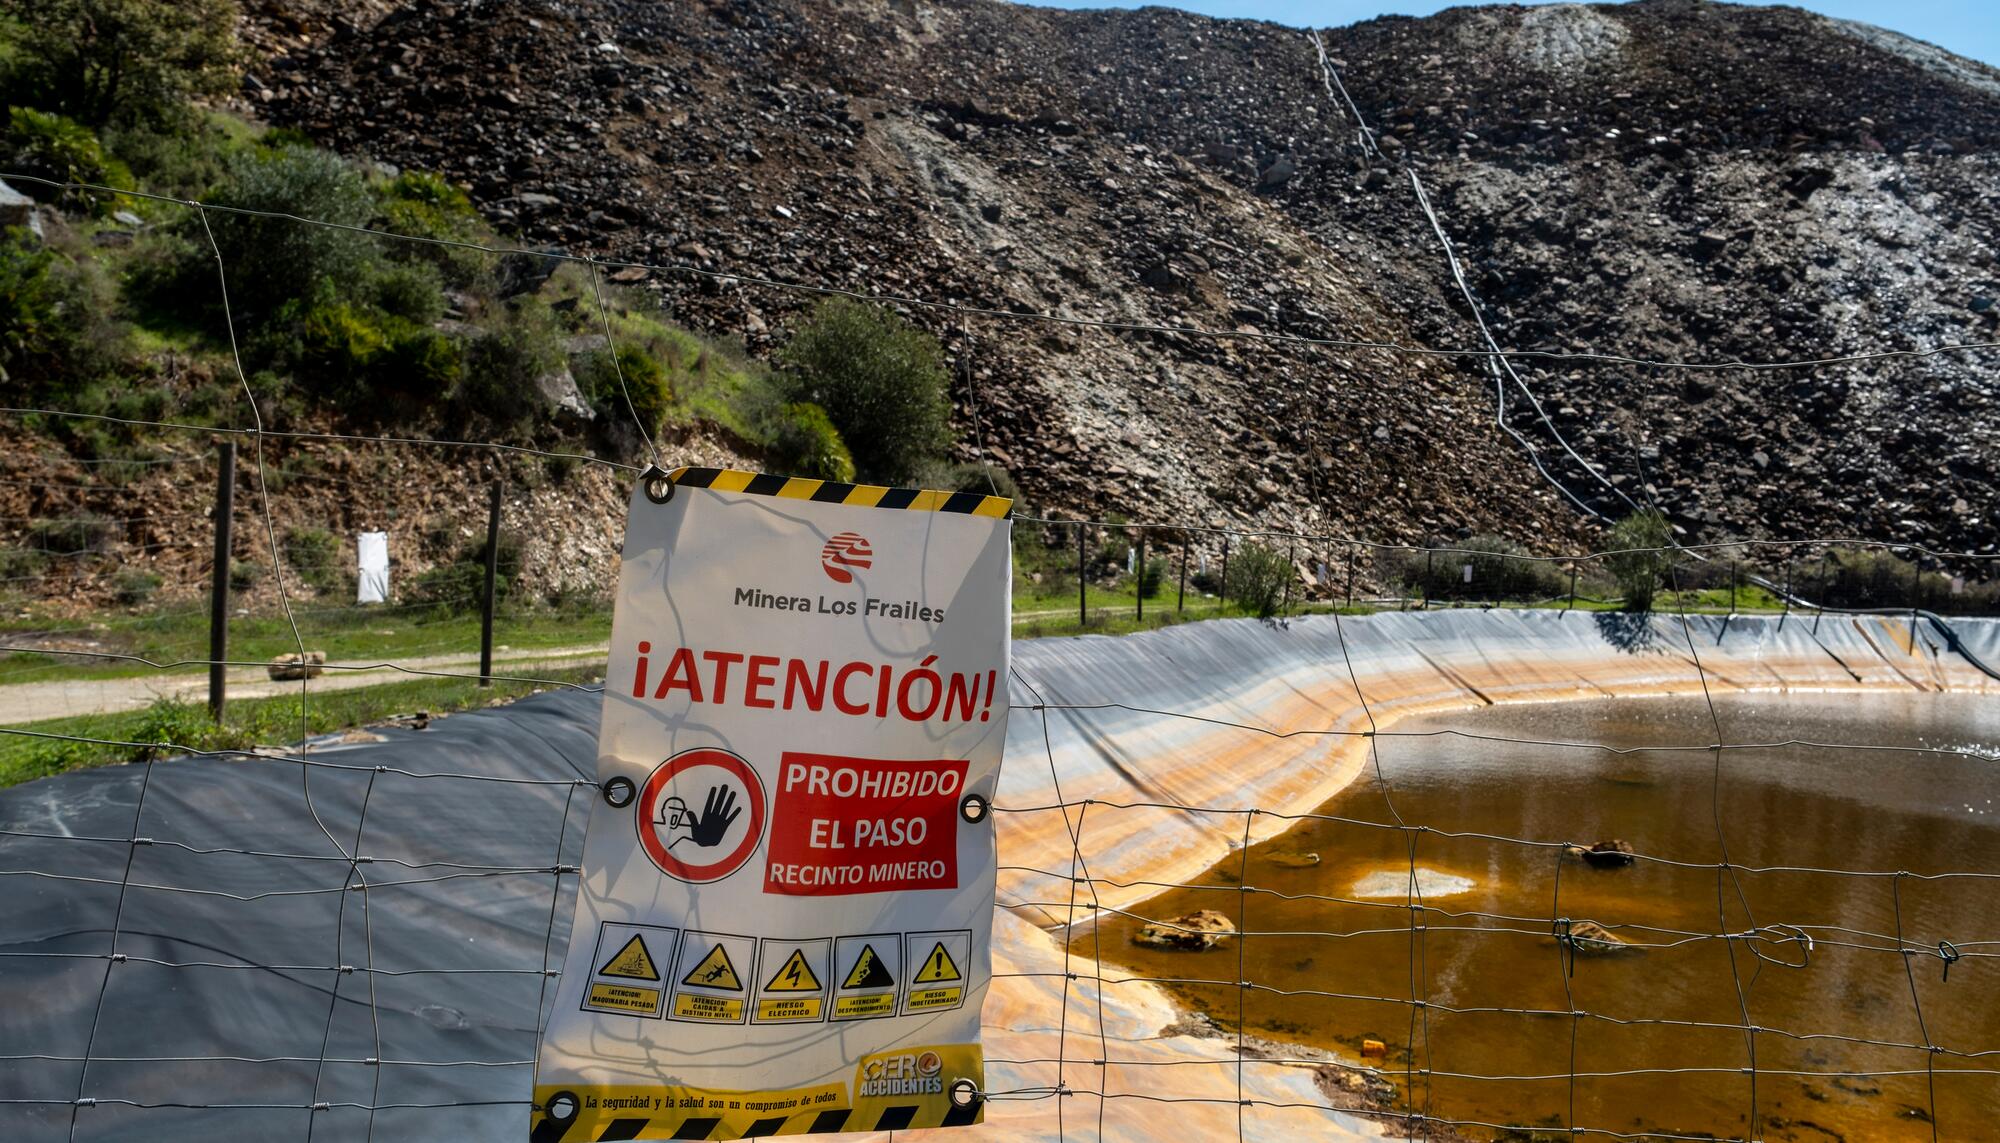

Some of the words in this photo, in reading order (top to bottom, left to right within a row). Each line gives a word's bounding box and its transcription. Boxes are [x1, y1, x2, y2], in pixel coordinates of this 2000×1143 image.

[734, 587, 811, 612] Minera
[818, 596, 857, 615] Los
[864, 598, 945, 623] Frailes
[632, 641, 997, 722] ¡ATENCIÓN!
[785, 763, 960, 798] PROHIBIDO
[809, 818, 845, 849] EL
[854, 817, 927, 848] PASO
[770, 862, 864, 885] RECINTO
[868, 860, 946, 882] MINERO
[592, 995, 629, 1006] MAQUINARIA
[630, 1000, 654, 1009] PESADA
[910, 996, 958, 1007] INDETERMINADO
[924, 991, 947, 999] RIESGO
[682, 1009, 712, 1017] DISTINTO
[860, 1076, 943, 1097] ACCIDENTES
[585, 1095, 598, 1108] La
[602, 1095, 650, 1111] seguridad
[654, 1099, 661, 1111] y
[665, 1095, 675, 1108] la
[679, 1095, 704, 1108] salud
[708, 1099, 724, 1109] son
[729, 1100, 741, 1110] un
[745, 1098, 797, 1113] compromiso
[800, 1096, 811, 1106] de
[814, 1091, 836, 1104] todos
